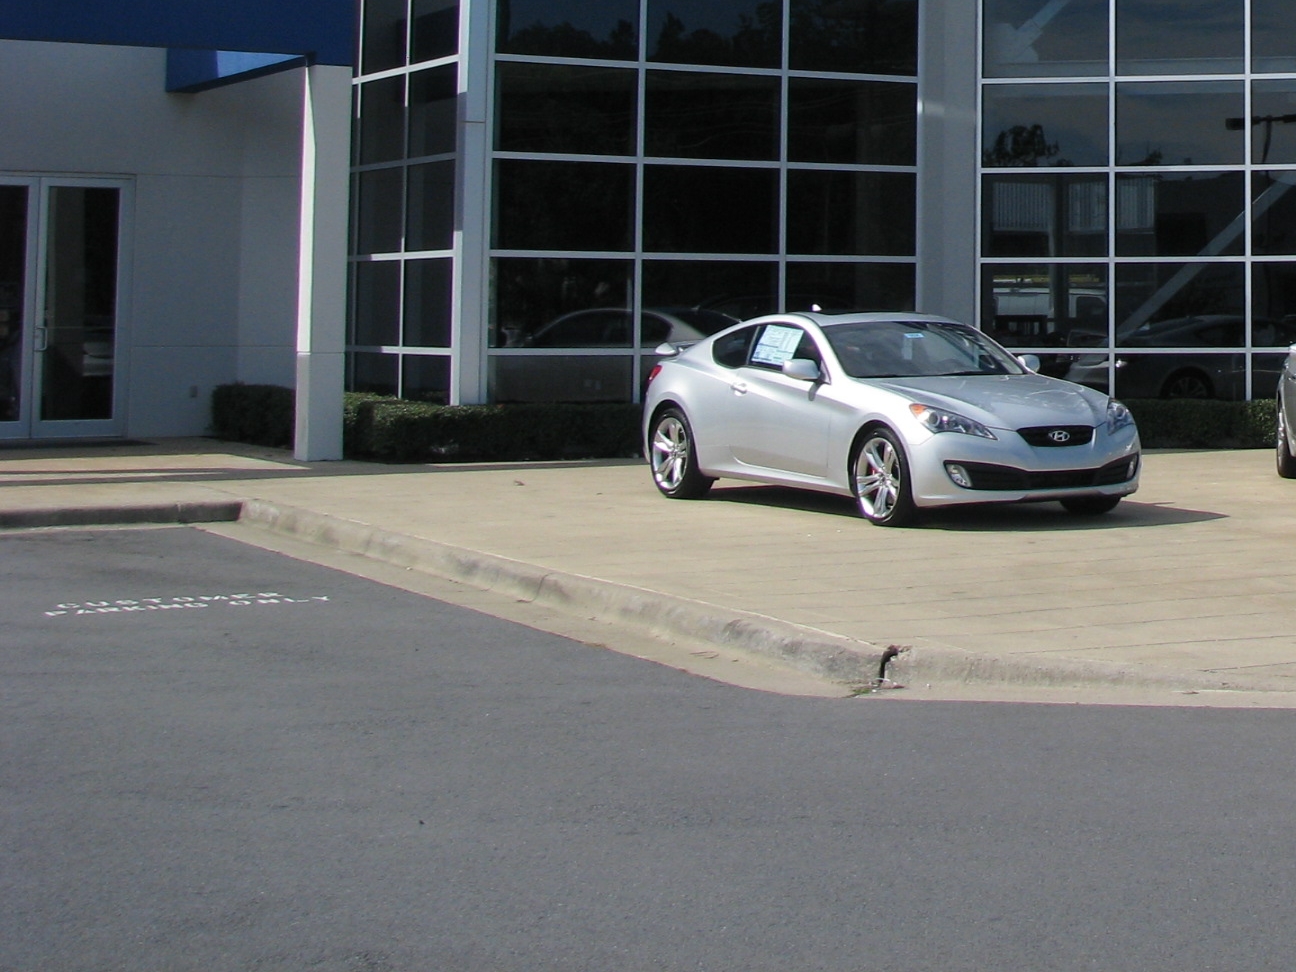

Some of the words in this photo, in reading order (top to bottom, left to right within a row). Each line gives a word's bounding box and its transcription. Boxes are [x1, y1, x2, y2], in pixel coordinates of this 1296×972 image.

[44, 602, 209, 617] PARKING
[228, 595, 331, 605] ONLY
[57, 592, 284, 609] CUSTOMER
